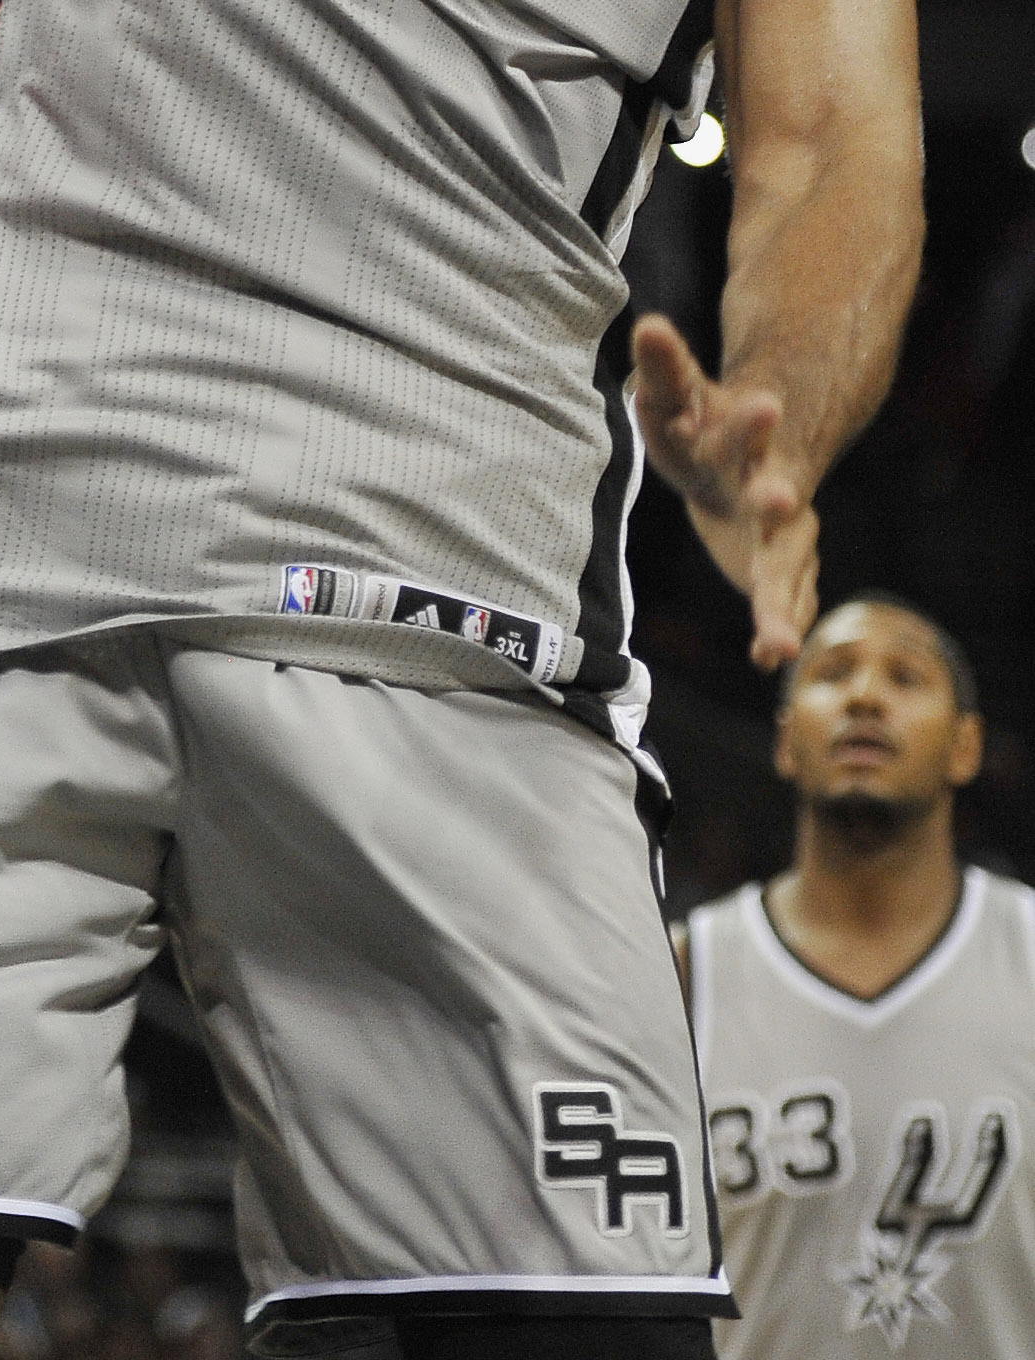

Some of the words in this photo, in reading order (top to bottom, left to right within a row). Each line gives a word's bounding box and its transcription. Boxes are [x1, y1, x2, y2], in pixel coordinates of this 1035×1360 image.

[494, 636, 530, 662] 3XL
[534, 1082, 689, 1237] SA
[708, 1090, 844, 1196] 33
